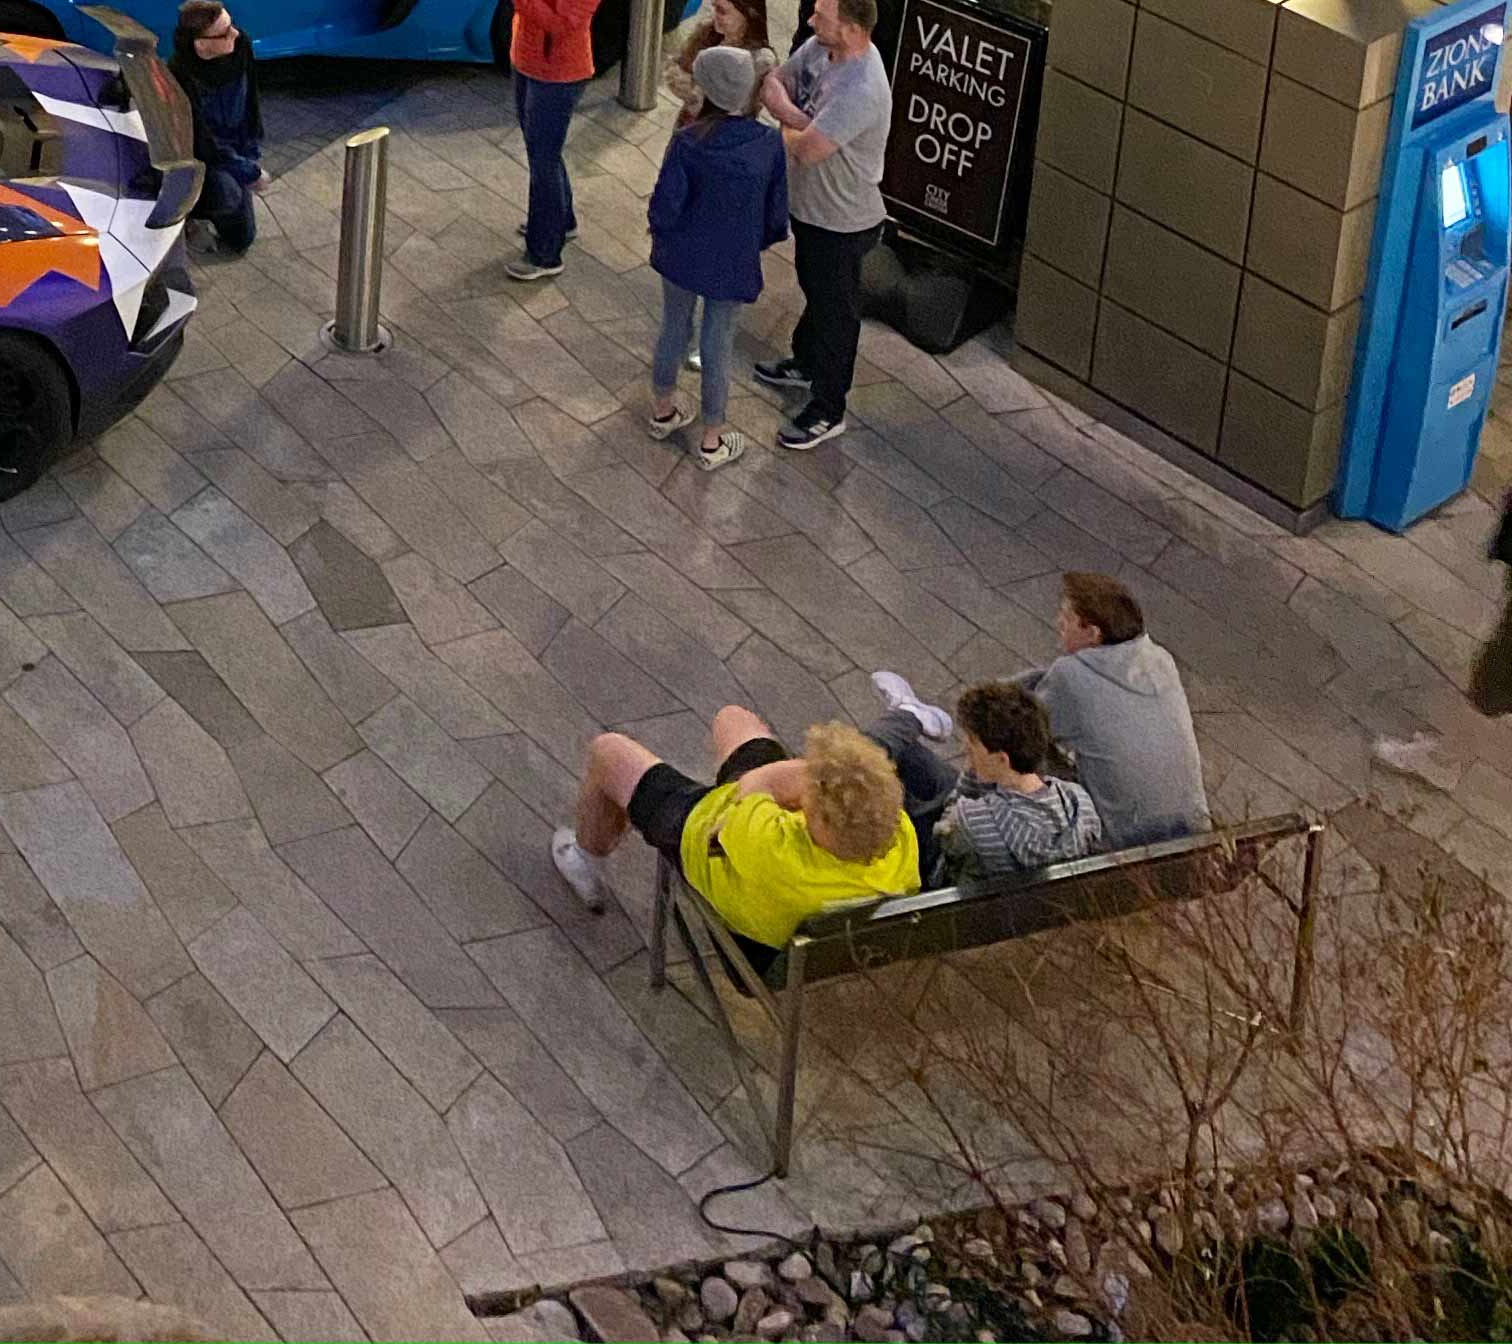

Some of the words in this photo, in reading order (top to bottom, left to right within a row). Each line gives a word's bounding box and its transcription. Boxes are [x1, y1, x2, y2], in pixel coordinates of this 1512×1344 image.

[916, 15, 1015, 81] VALET
[909, 53, 1006, 108] PARKING
[1420, 55, 1486, 112] BANK
[907, 93, 993, 149] DROP
[914, 133, 975, 178] OFF
